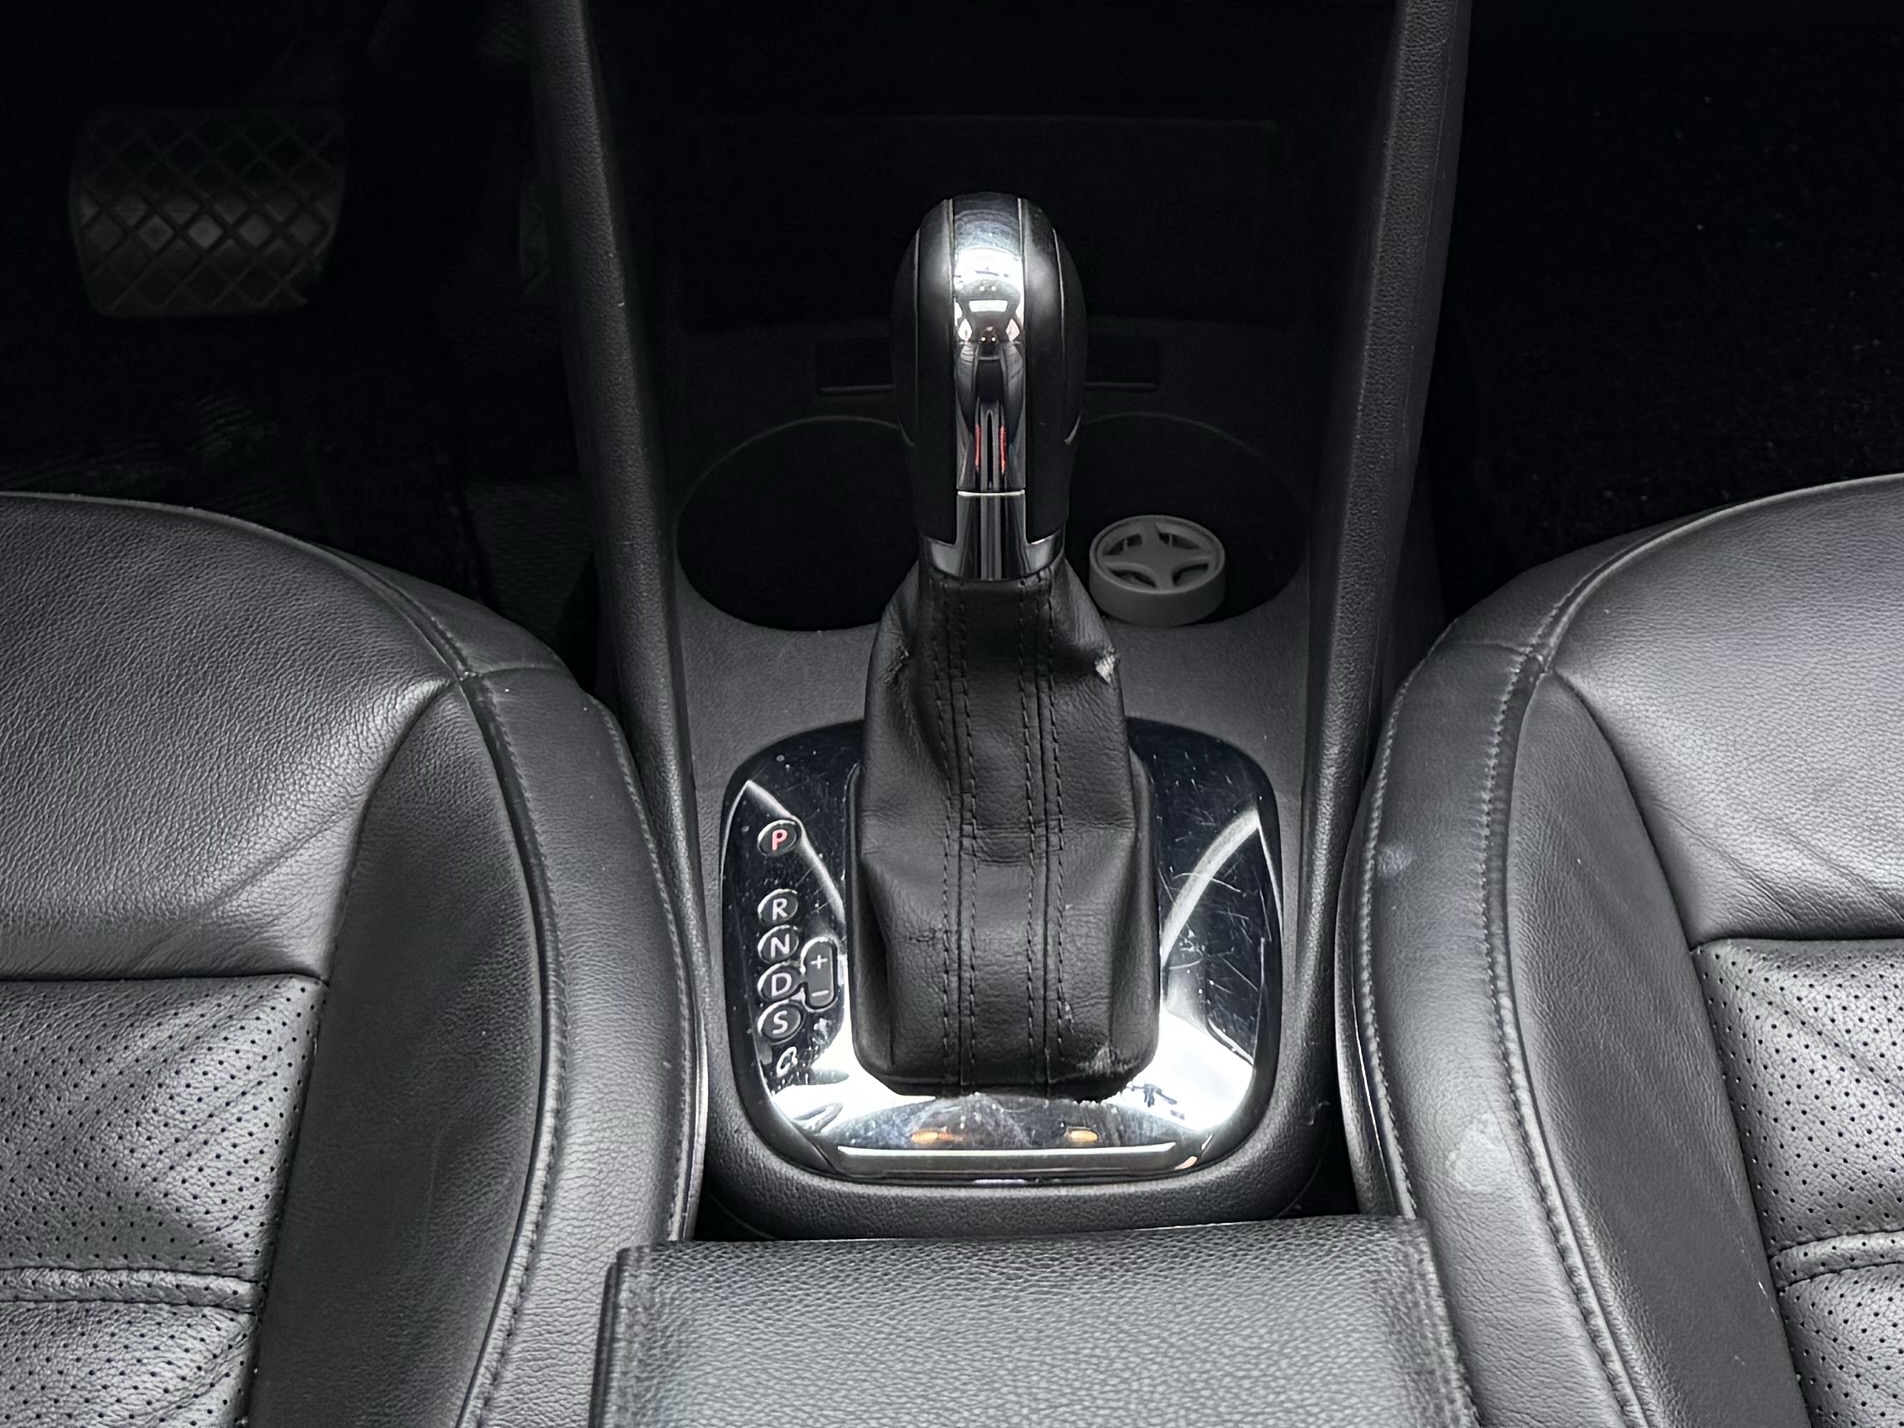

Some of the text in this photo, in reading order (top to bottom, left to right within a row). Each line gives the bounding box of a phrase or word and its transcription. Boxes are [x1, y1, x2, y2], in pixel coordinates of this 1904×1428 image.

[770, 829, 788, 849] P
[770, 898, 788, 918] R
[769, 937, 791, 957] N
[770, 971, 793, 994] D
[770, 1010, 788, 1033] S
